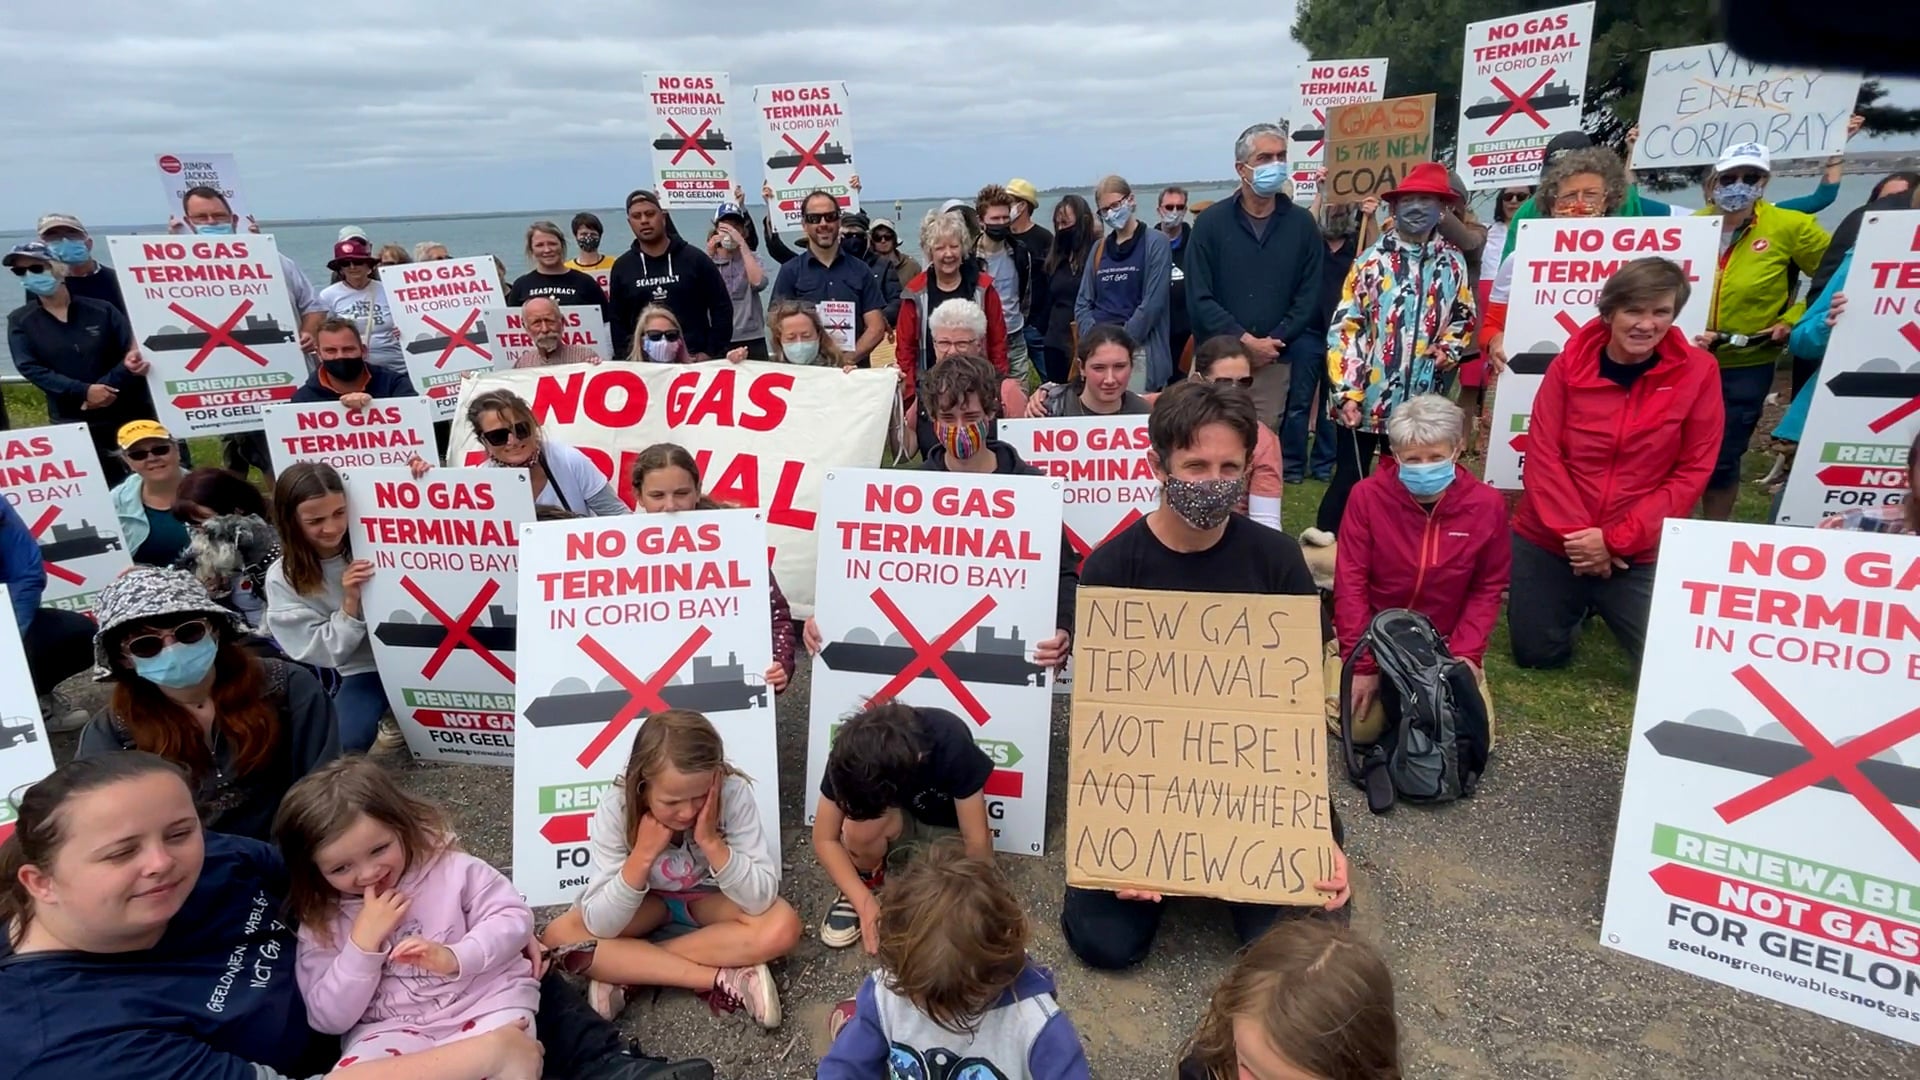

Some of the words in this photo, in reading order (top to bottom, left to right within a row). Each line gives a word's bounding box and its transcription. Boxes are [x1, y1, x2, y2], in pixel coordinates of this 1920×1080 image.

[1488, 23, 1518, 41] NO
[1524, 14, 1568, 34] GAS
[1473, 33, 1580, 62] TERMINAL
[1312, 67, 1334, 79] NO
[1338, 66, 1369, 77] GAS
[1478, 65, 1491, 75] IN
[1495, 57, 1536, 72] CORIO
[1540, 52, 1573, 66] BAY!
[659, 77, 680, 89] NO
[683, 77, 714, 89] GAS
[772, 89, 795, 102] NO
[798, 87, 830, 100] GAS
[1300, 82, 1377, 95] TERMINAL
[650, 92, 725, 105] TERMINAL
[1303, 97, 1313, 106] IN
[1316, 96, 1346, 106] CORIO
[1677, 75, 1823, 115] ENERGY
[656, 107, 666, 116] IN
[668, 107, 697, 116] CORIO
[700, 107, 721, 116] BAY!
[763, 103, 843, 119] TERMINAL
[1339, 99, 1424, 135] GAS
[770, 123, 781, 131] IN
[783, 120, 814, 131] CORIO
[817, 118, 839, 128] BAY!
[1764, 110, 1846, 154] BAY
[1336, 147, 1349, 162] IS
[1355, 143, 1380, 160] THE
[1386, 134, 1429, 157] NEW
[1475, 136, 1554, 152] RENEWABLE
[1487, 153, 1514, 164] NOT
[1516, 150, 1542, 161] GAS
[665, 171, 723, 179] RENEWABLES
[1473, 167, 1497, 177] FOR
[676, 181, 695, 189] NOT
[697, 181, 714, 189] GAS
[1554, 229, 1603, 252] NO
[1612, 228, 1682, 252] GAS
[143, 243, 186, 261] NO
[192, 243, 248, 259] GAS
[129, 264, 273, 283] TERMINAL
[403, 269, 432, 284] NO
[436, 264, 476, 280] GAS
[636, 274, 681, 287] SEASPIRACY
[1528, 260, 1700, 283] TERML
[145, 288, 164, 299] IN
[168, 284, 224, 298] CORIO
[230, 283, 268, 296] BAY!
[394, 279, 493, 302] TERMINAL
[529, 287, 577, 296] SEASPIRACY
[1535, 290, 1556, 304] IN
[405, 304, 419, 314] IN
[422, 299, 461, 312] CORIO
[464, 295, 491, 307] BAY!
[1873, 297, 1906, 315] IN
[560, 313, 581, 327] AS
[176, 374, 286, 392] RENEWABLES
[201, 393, 234, 406] NOT
[238, 389, 272, 402] GAS
[532, 370, 649, 430] NO
[665, 368, 796, 432] GAS
[185, 409, 218, 421] FOR
[221, 403, 272, 417] GEEL
[297, 409, 339, 430] NO
[346, 407, 402, 426] GAS
[1, 437, 53, 460] AS
[281, 429, 424, 455] TERMINAL
[1033, 429, 1078, 452] NO
[1087, 427, 1152, 451] GAS
[380, 450, 418, 465] BAY
[1027, 457, 1154, 482] ERMINA
[28, 483, 82, 504] BAY!
[375, 482, 421, 509] NO
[427, 483, 495, 510] GAS
[865, 483, 922, 514] NO
[933, 487, 1015, 519] GAS
[1063, 487, 1111, 503] ORIO
[1118, 486, 1158, 503] BAY
[1824, 490, 1877, 506] FOR
[360, 517, 519, 546] TERMINAL
[566, 529, 626, 560] NO
[636, 524, 721, 555] GAS
[836, 521, 1041, 560] TERMINAL
[375, 551, 396, 569] IN
[401, 551, 464, 572] CORIO
[470, 554, 518, 573] BAY!
[1728, 541, 1827, 581] NO
[537, 560, 751, 601] TERMINAL
[847, 559, 870, 580] IN
[878, 561, 958, 585] CORIO
[967, 566, 1026, 589] BAY!
[551, 607, 575, 629] IN
[585, 601, 669, 626] CORIO
[679, 596, 739, 620] BAY!
[1682, 580, 1920, 641] TERMIN
[1087, 600, 1188, 640] NEW
[1200, 604, 1289, 649] GAS
[1695, 625, 1735, 653] IN
[1748, 633, 1891, 675] CORIO
[1083, 647, 1310, 705] TERMINAL?
[442, 713, 481, 728] NOT
[487, 715, 514, 730] GA
[429, 730, 466, 745] FOR
[470, 732, 514, 748] GEEL
[1083, 710, 1164, 758] NOT
[1079, 768, 1155, 814] NOT
[1163, 776, 1328, 830] ANYWHERE
[556, 847, 590, 870] FO
[1075, 825, 1137, 871] NO
[1146, 828, 1238, 884] NEW
[1675, 833, 1920, 918] RENEWABL
[1667, 902, 1748, 947] FOR
[1718, 881, 1812, 926] NOT
[1820, 911, 1920, 958] GAS
[1668, 938, 1920, 1022] geelongrenewablesnotgas
